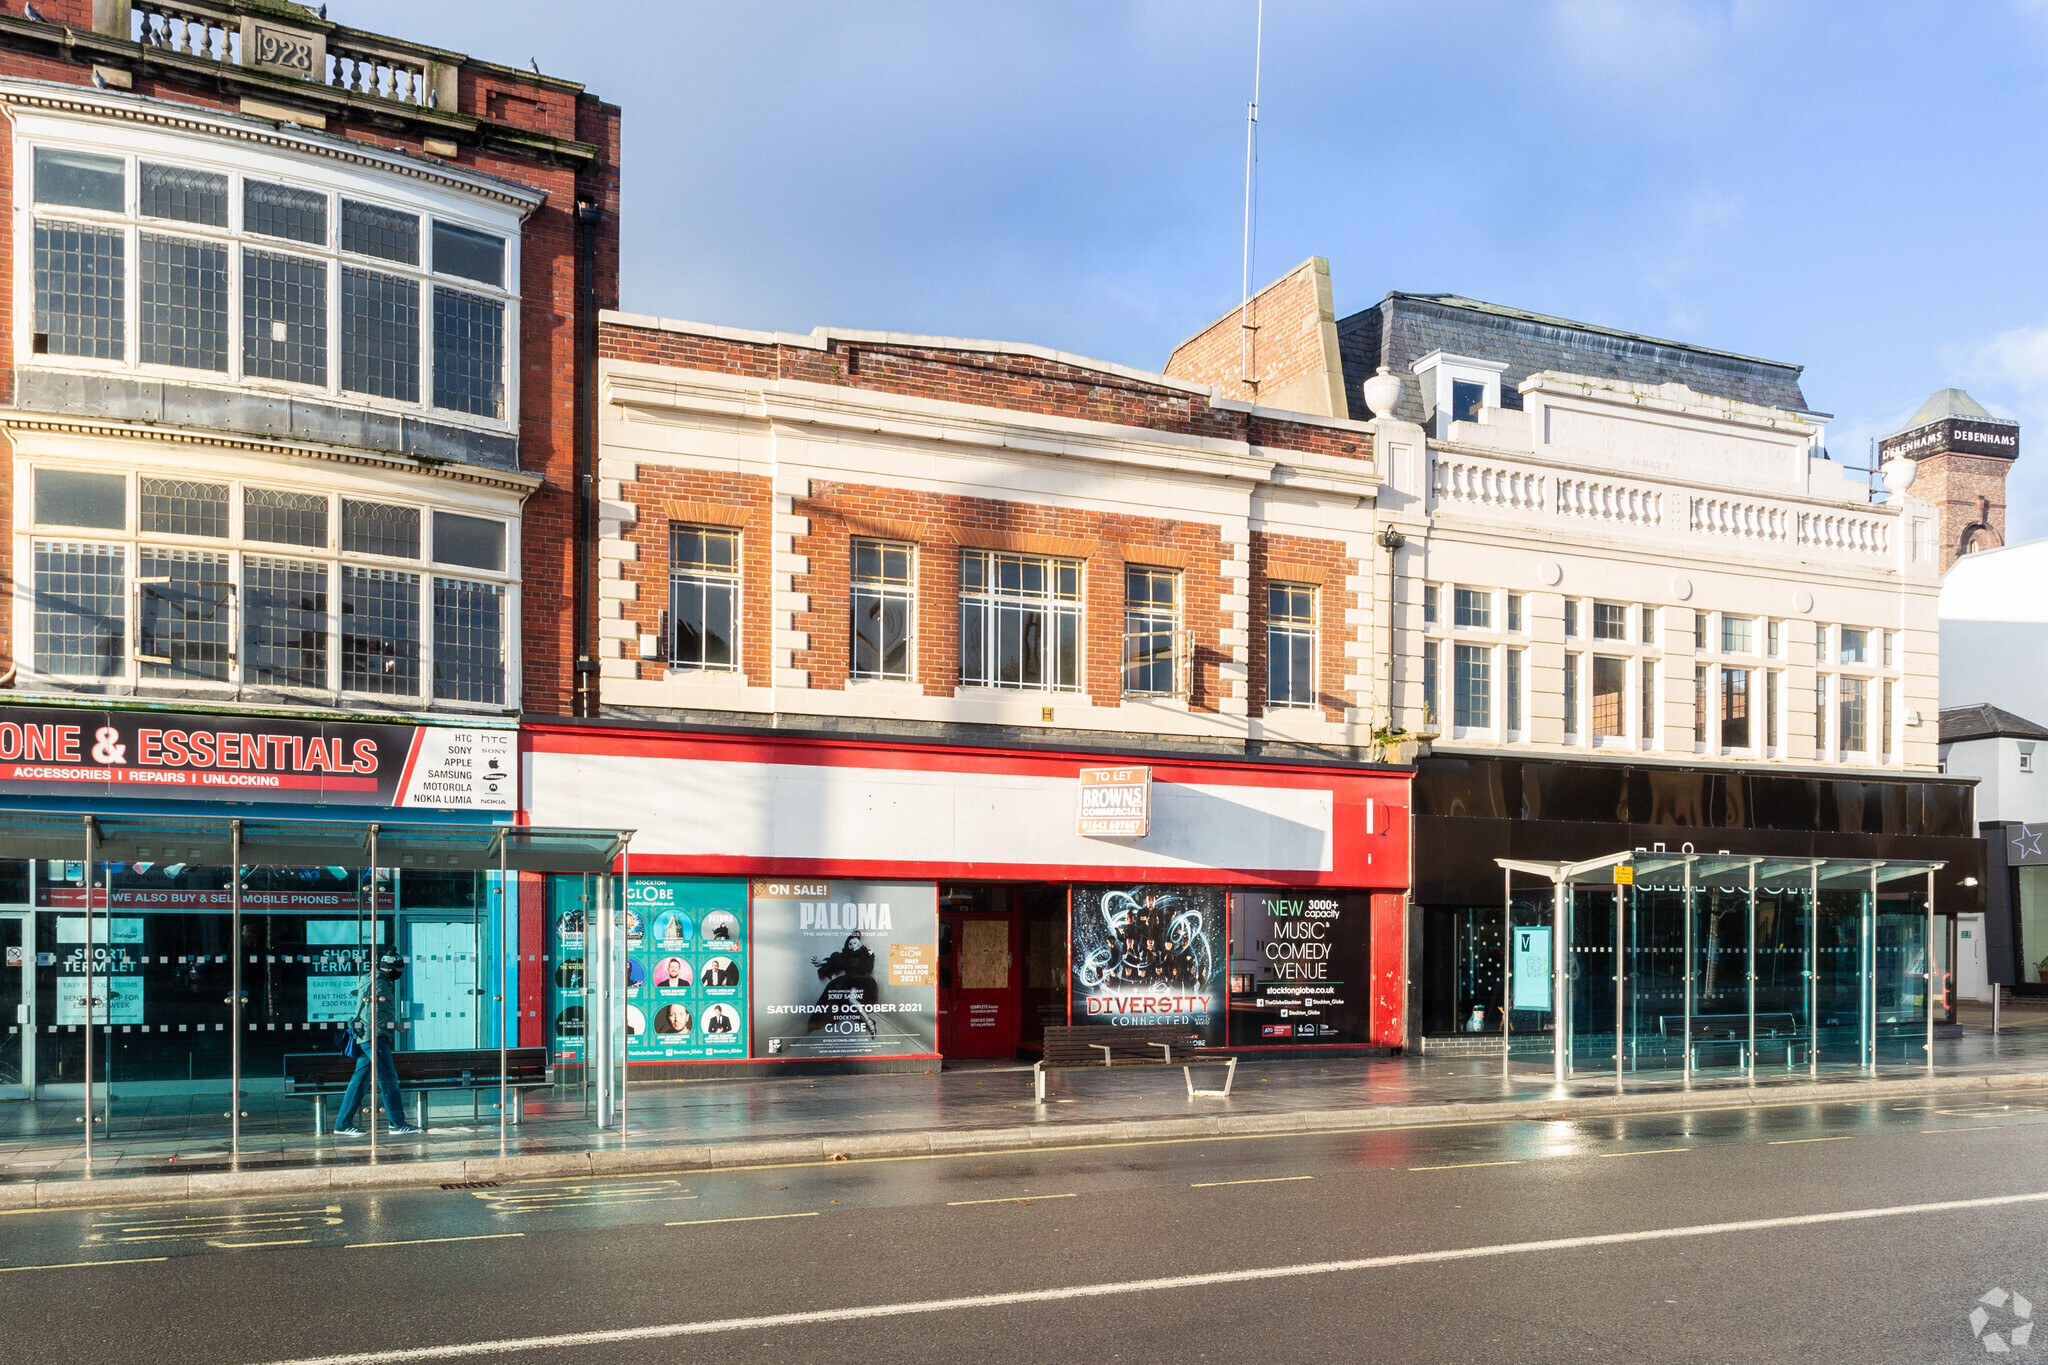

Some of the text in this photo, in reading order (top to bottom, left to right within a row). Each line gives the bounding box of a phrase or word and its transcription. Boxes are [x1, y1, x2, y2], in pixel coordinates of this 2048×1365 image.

[256, 32, 311, 70] 1928
[1954, 429, 2016, 446] DEBENHAMS
[1882, 431, 1943, 460] DEBENHAMS
[455, 734, 472, 743] HTC
[91, 726, 127, 765] &
[138, 728, 379, 774] ESSENTIALS
[448, 746, 472, 755] SONY
[444, 758, 473, 768] APPLE
[13, 767, 112, 781] ACCESSORIES
[129, 771, 186, 783] REPAIRS
[202, 774, 280, 787] UNLOCKING
[428, 770, 473, 780] SAMSUNG
[1094, 771, 1133, 781] TO LET
[423, 782, 473, 792] MOTOROLA
[414, 794, 473, 805] NOKIA LUMIA
[1082, 788, 1142, 808] BROWNS
[1082, 808, 1142, 817] COMMERCIAL
[627, 886, 674, 902] GLOBE
[768, 884, 827, 896] ON SALE!
[112, 893, 339, 905] WE ALSO BUY & SEL MOBILE PHONES
[1308, 900, 1339, 910] 3000+
[1267, 900, 1304, 917] NEW
[1305, 909, 1340, 919] capacity
[799, 902, 893, 930] PALOMA
[1274, 921, 1325, 939] MUSIC
[1265, 942, 1332, 960] COMEDY
[111, 962, 137, 972] LET
[312, 961, 351, 972] TERM
[1273, 962, 1327, 979] VENUE
[1266, 986, 1335, 996] stocktonglobe.co.uk
[767, 1003, 922, 1014] SATURDAY 9 OCTOBER 2021
[1086, 996, 1213, 1016] DIVERSITY
[1111, 1015, 1189, 1026] CONNECTED
[825, 1021, 867, 1034] GLOBE
